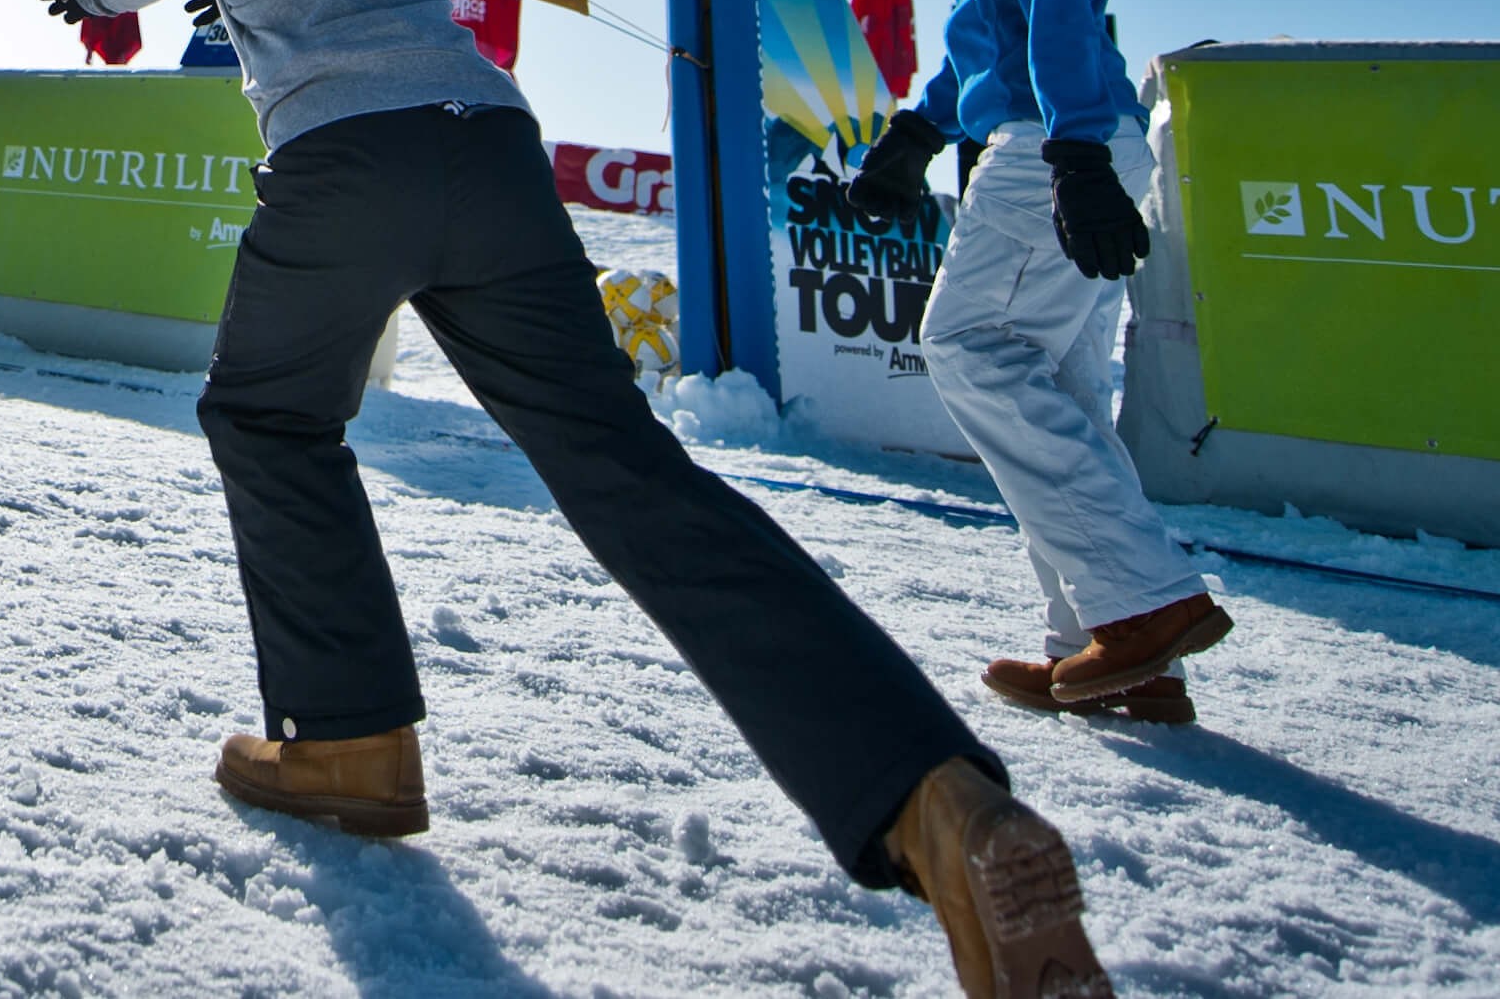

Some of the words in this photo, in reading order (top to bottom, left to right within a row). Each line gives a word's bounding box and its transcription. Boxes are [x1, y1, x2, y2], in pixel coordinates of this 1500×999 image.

[29, 146, 266, 195] NUTRILIT
[834, 342, 871, 356] powered
[873, 344, 884, 361] by
